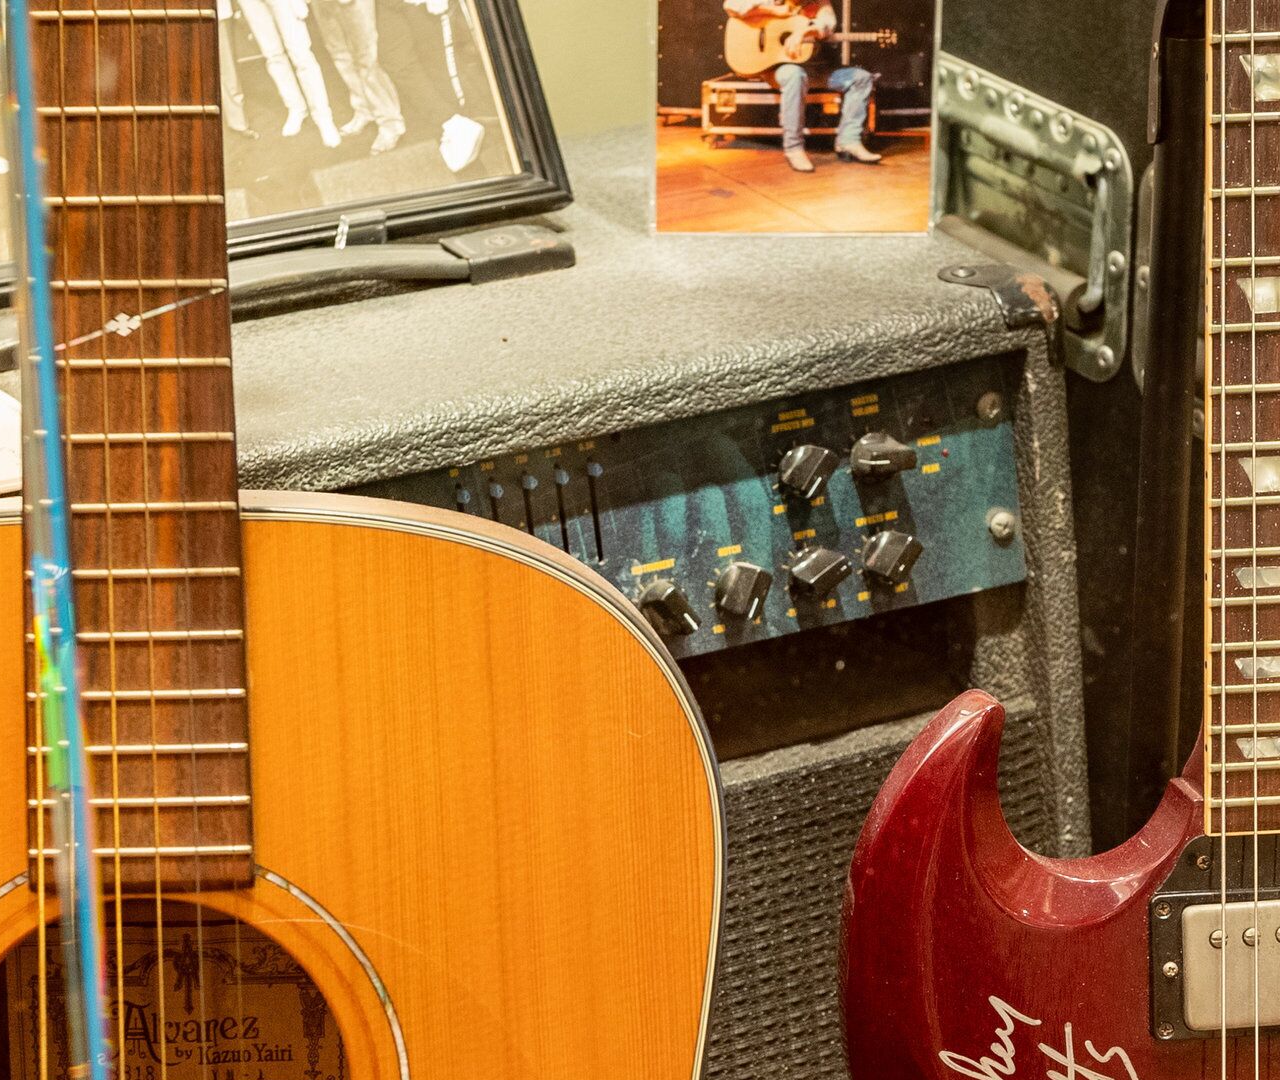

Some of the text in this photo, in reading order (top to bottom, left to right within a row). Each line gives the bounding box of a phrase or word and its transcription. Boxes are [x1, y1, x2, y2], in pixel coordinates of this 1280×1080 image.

[110, 1002, 260, 1066] Alvarez
[175, 1044, 294, 1066] by Kazuo Yairi
